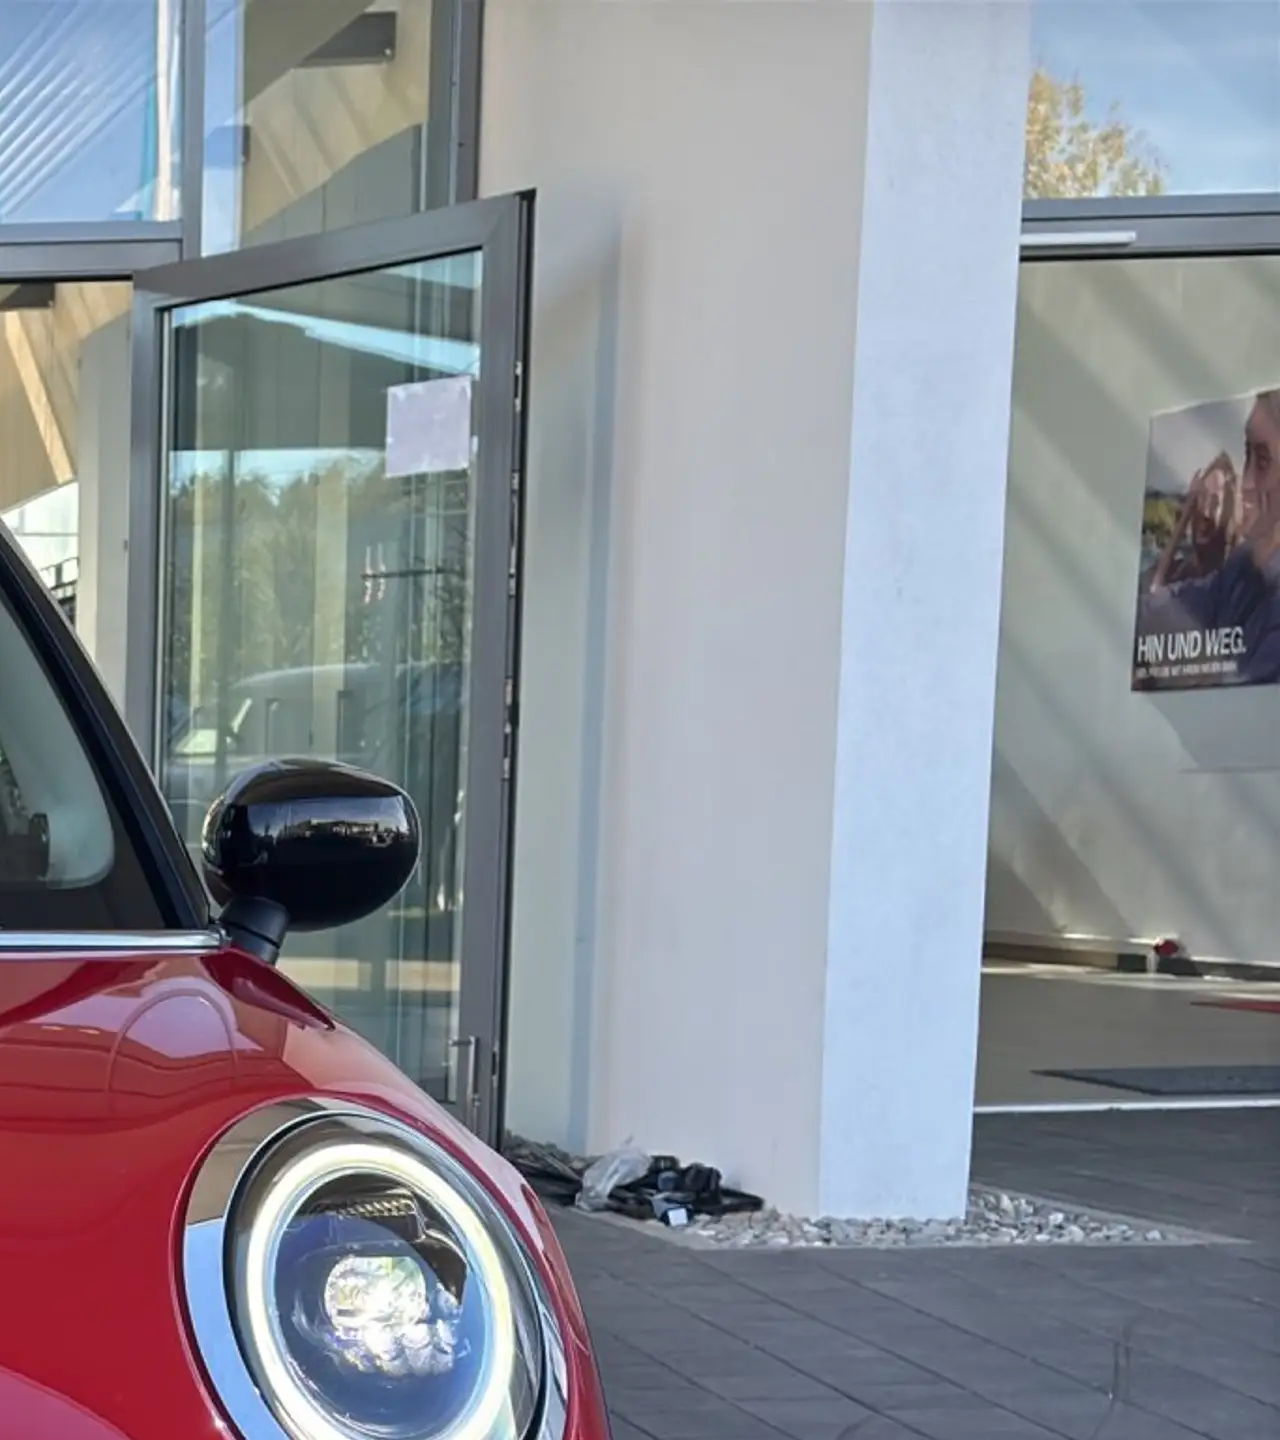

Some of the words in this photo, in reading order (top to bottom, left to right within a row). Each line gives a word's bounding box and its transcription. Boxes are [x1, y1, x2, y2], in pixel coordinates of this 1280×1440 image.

[1138, 634, 1164, 663] HIN
[1167, 630, 1201, 660] UND
[1205, 627, 1247, 657] WEG.
